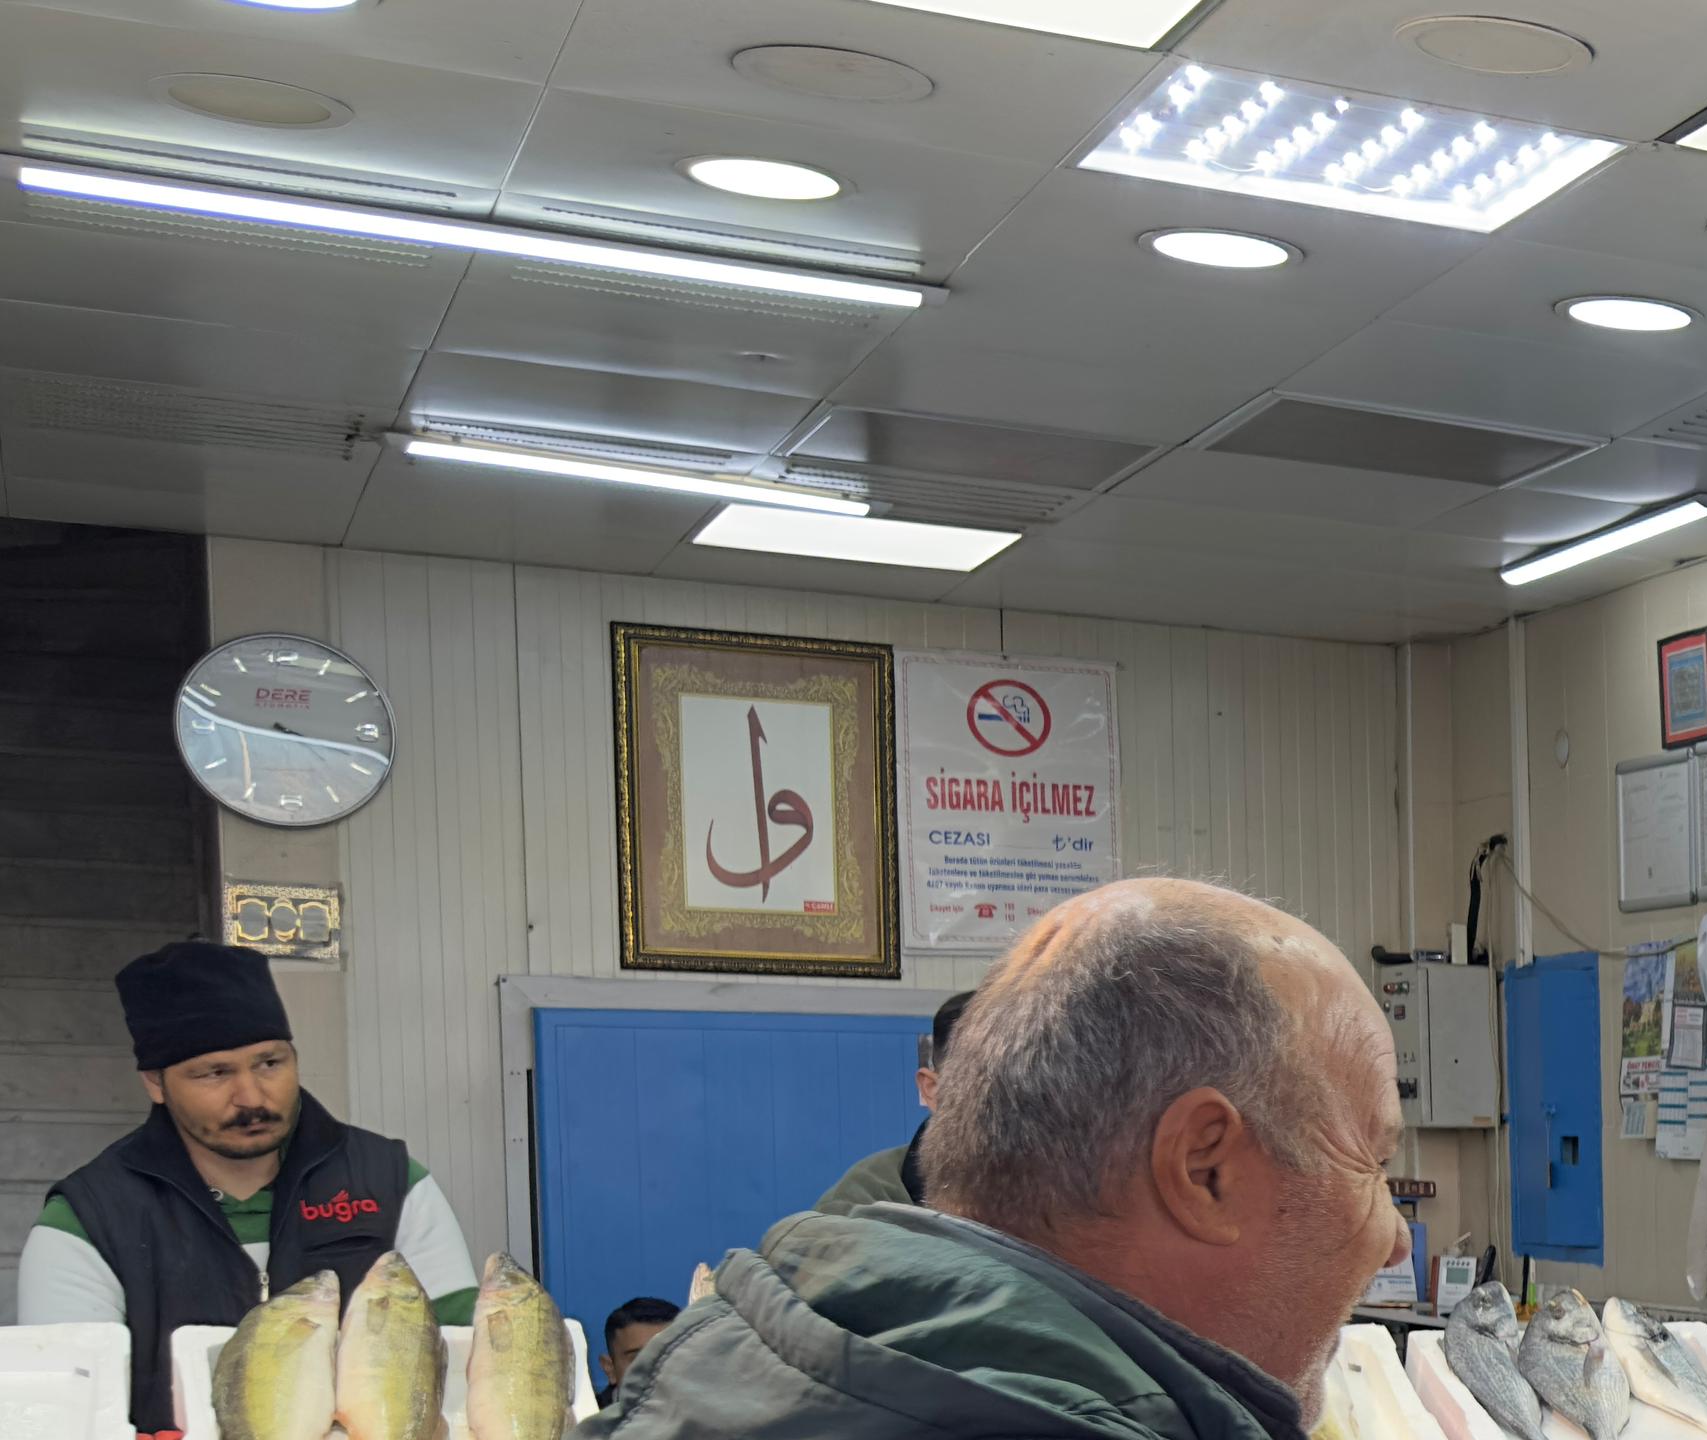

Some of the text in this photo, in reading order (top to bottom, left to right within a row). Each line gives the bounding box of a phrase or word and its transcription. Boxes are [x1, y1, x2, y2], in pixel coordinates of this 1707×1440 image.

[256, 688, 312, 701] DERE
[925, 767, 1096, 823] SİGARA İÇİLMEZ
[929, 830, 990, 846] CEZASI
